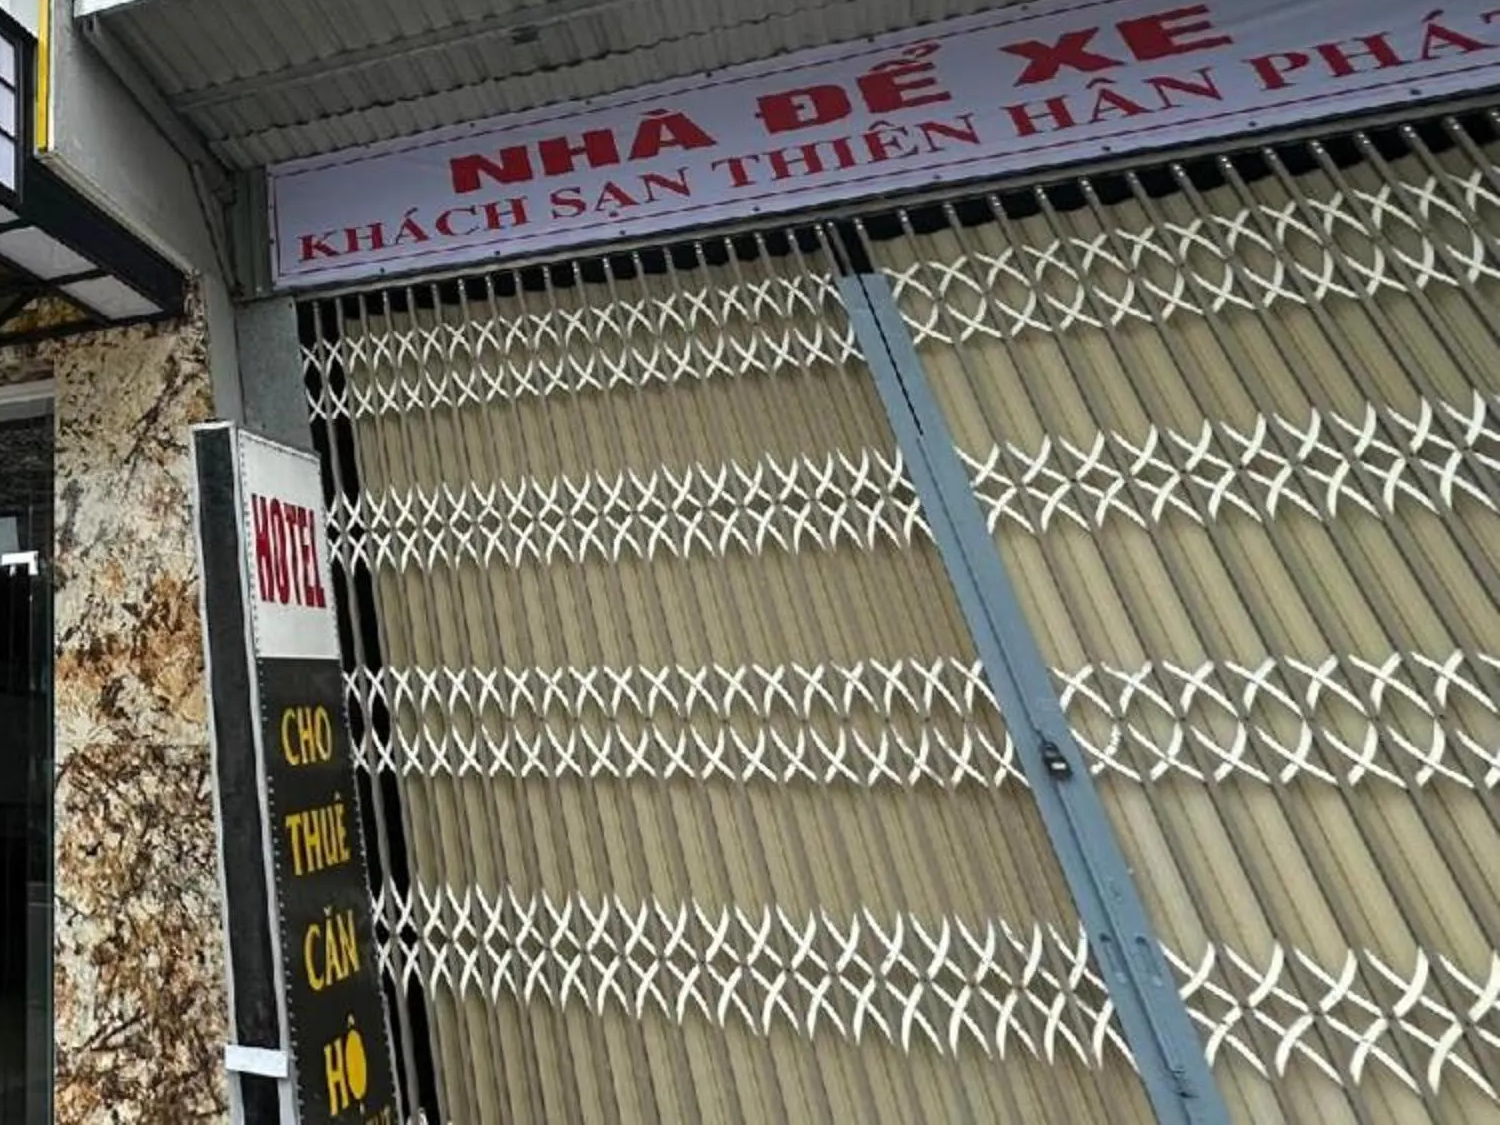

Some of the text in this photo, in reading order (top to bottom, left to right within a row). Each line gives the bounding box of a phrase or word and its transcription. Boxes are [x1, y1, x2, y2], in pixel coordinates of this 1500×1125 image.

[449, 4, 1234, 194] NHÀ ĐỂ XE
[298, 194, 529, 263] KHÁCH
[549, 166, 691, 220] SẠN
[710, 113, 982, 189] THIÊN
[1000, 66, 1223, 139] HÂN
[251, 493, 327, 609] HOTEL
[280, 706, 333, 767] CHO
[285, 792, 351, 876] THUÊ
[304, 907, 360, 991] CĂN
